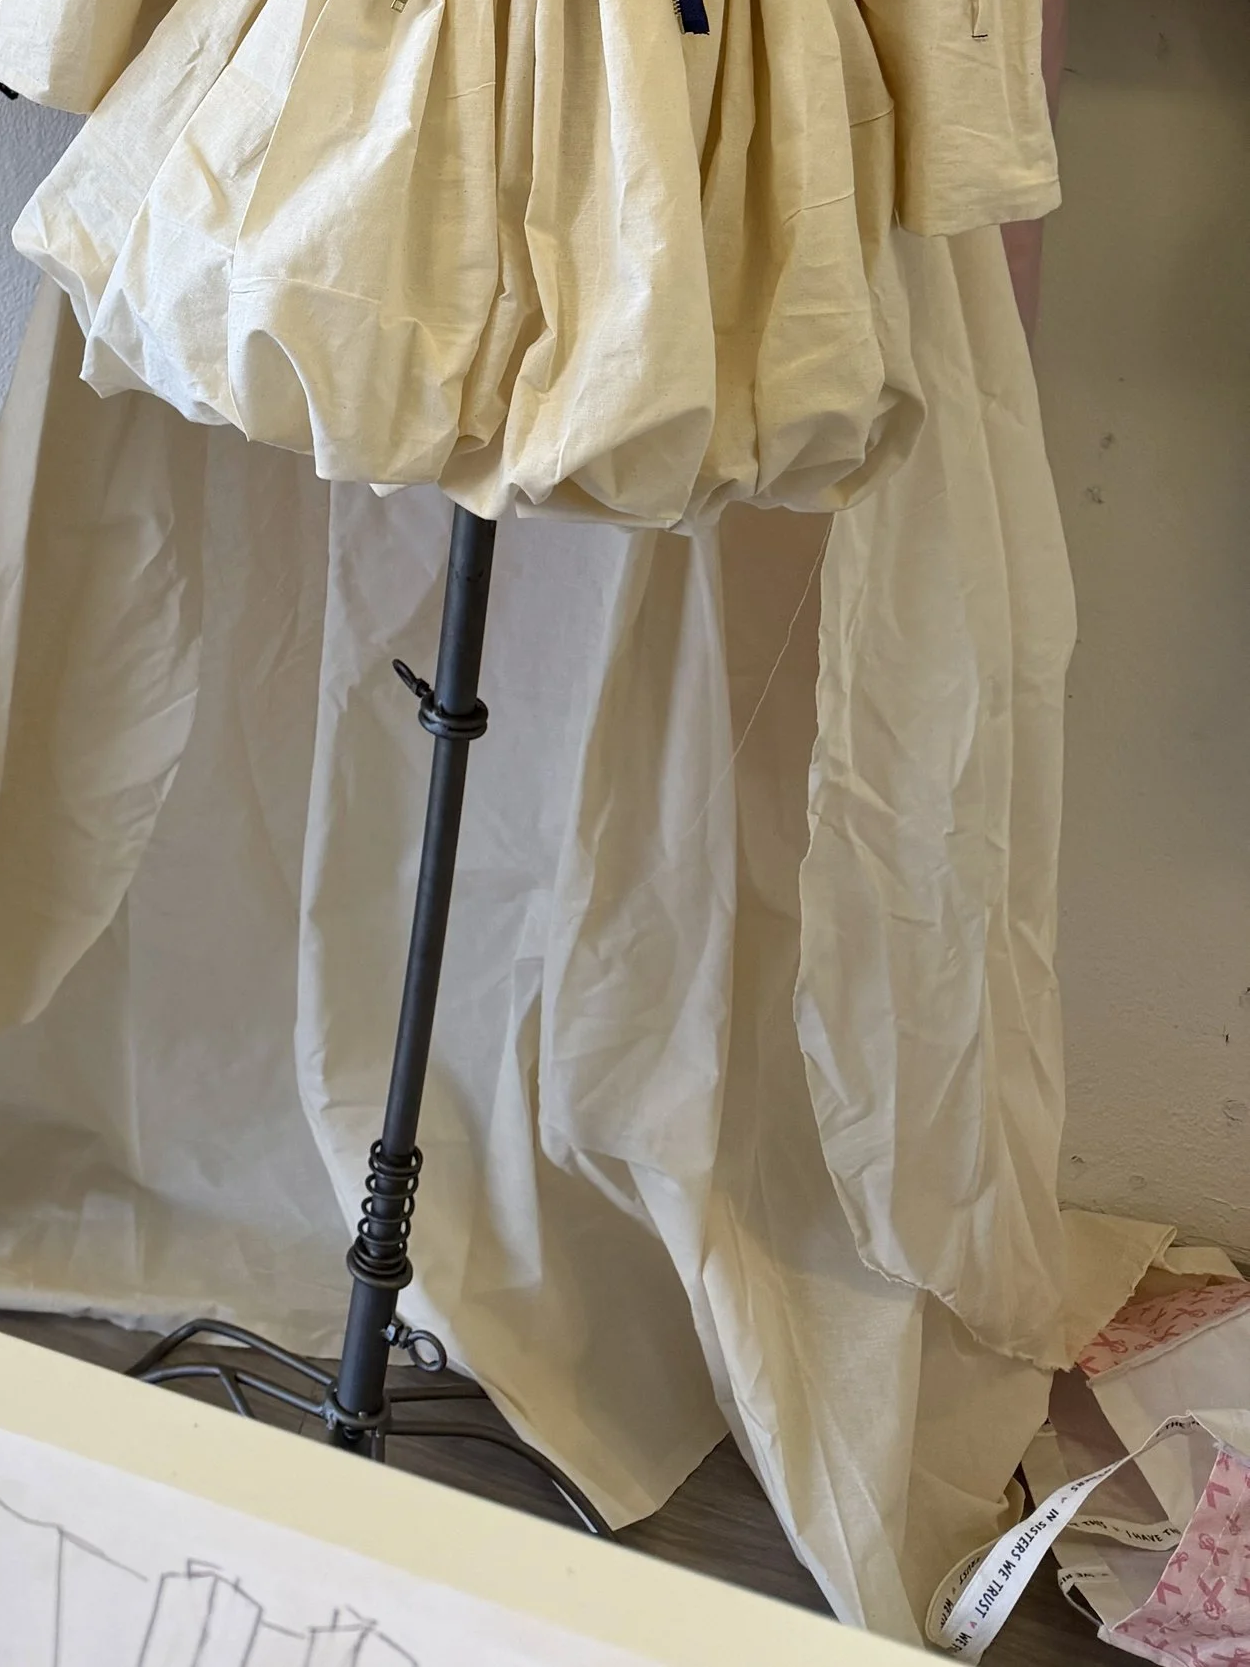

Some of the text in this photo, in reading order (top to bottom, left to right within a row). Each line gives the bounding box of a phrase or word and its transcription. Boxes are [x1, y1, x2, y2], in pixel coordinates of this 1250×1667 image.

[1046, 1508, 1059, 1522] IN
[1011, 1521, 1047, 1561] SISTERS
[1132, 1532, 1163, 1543] HAVE
[998, 1560, 1016, 1581] WE
[975, 1580, 1004, 1619] TRUST
[955, 1632, 972, 1647] WE
